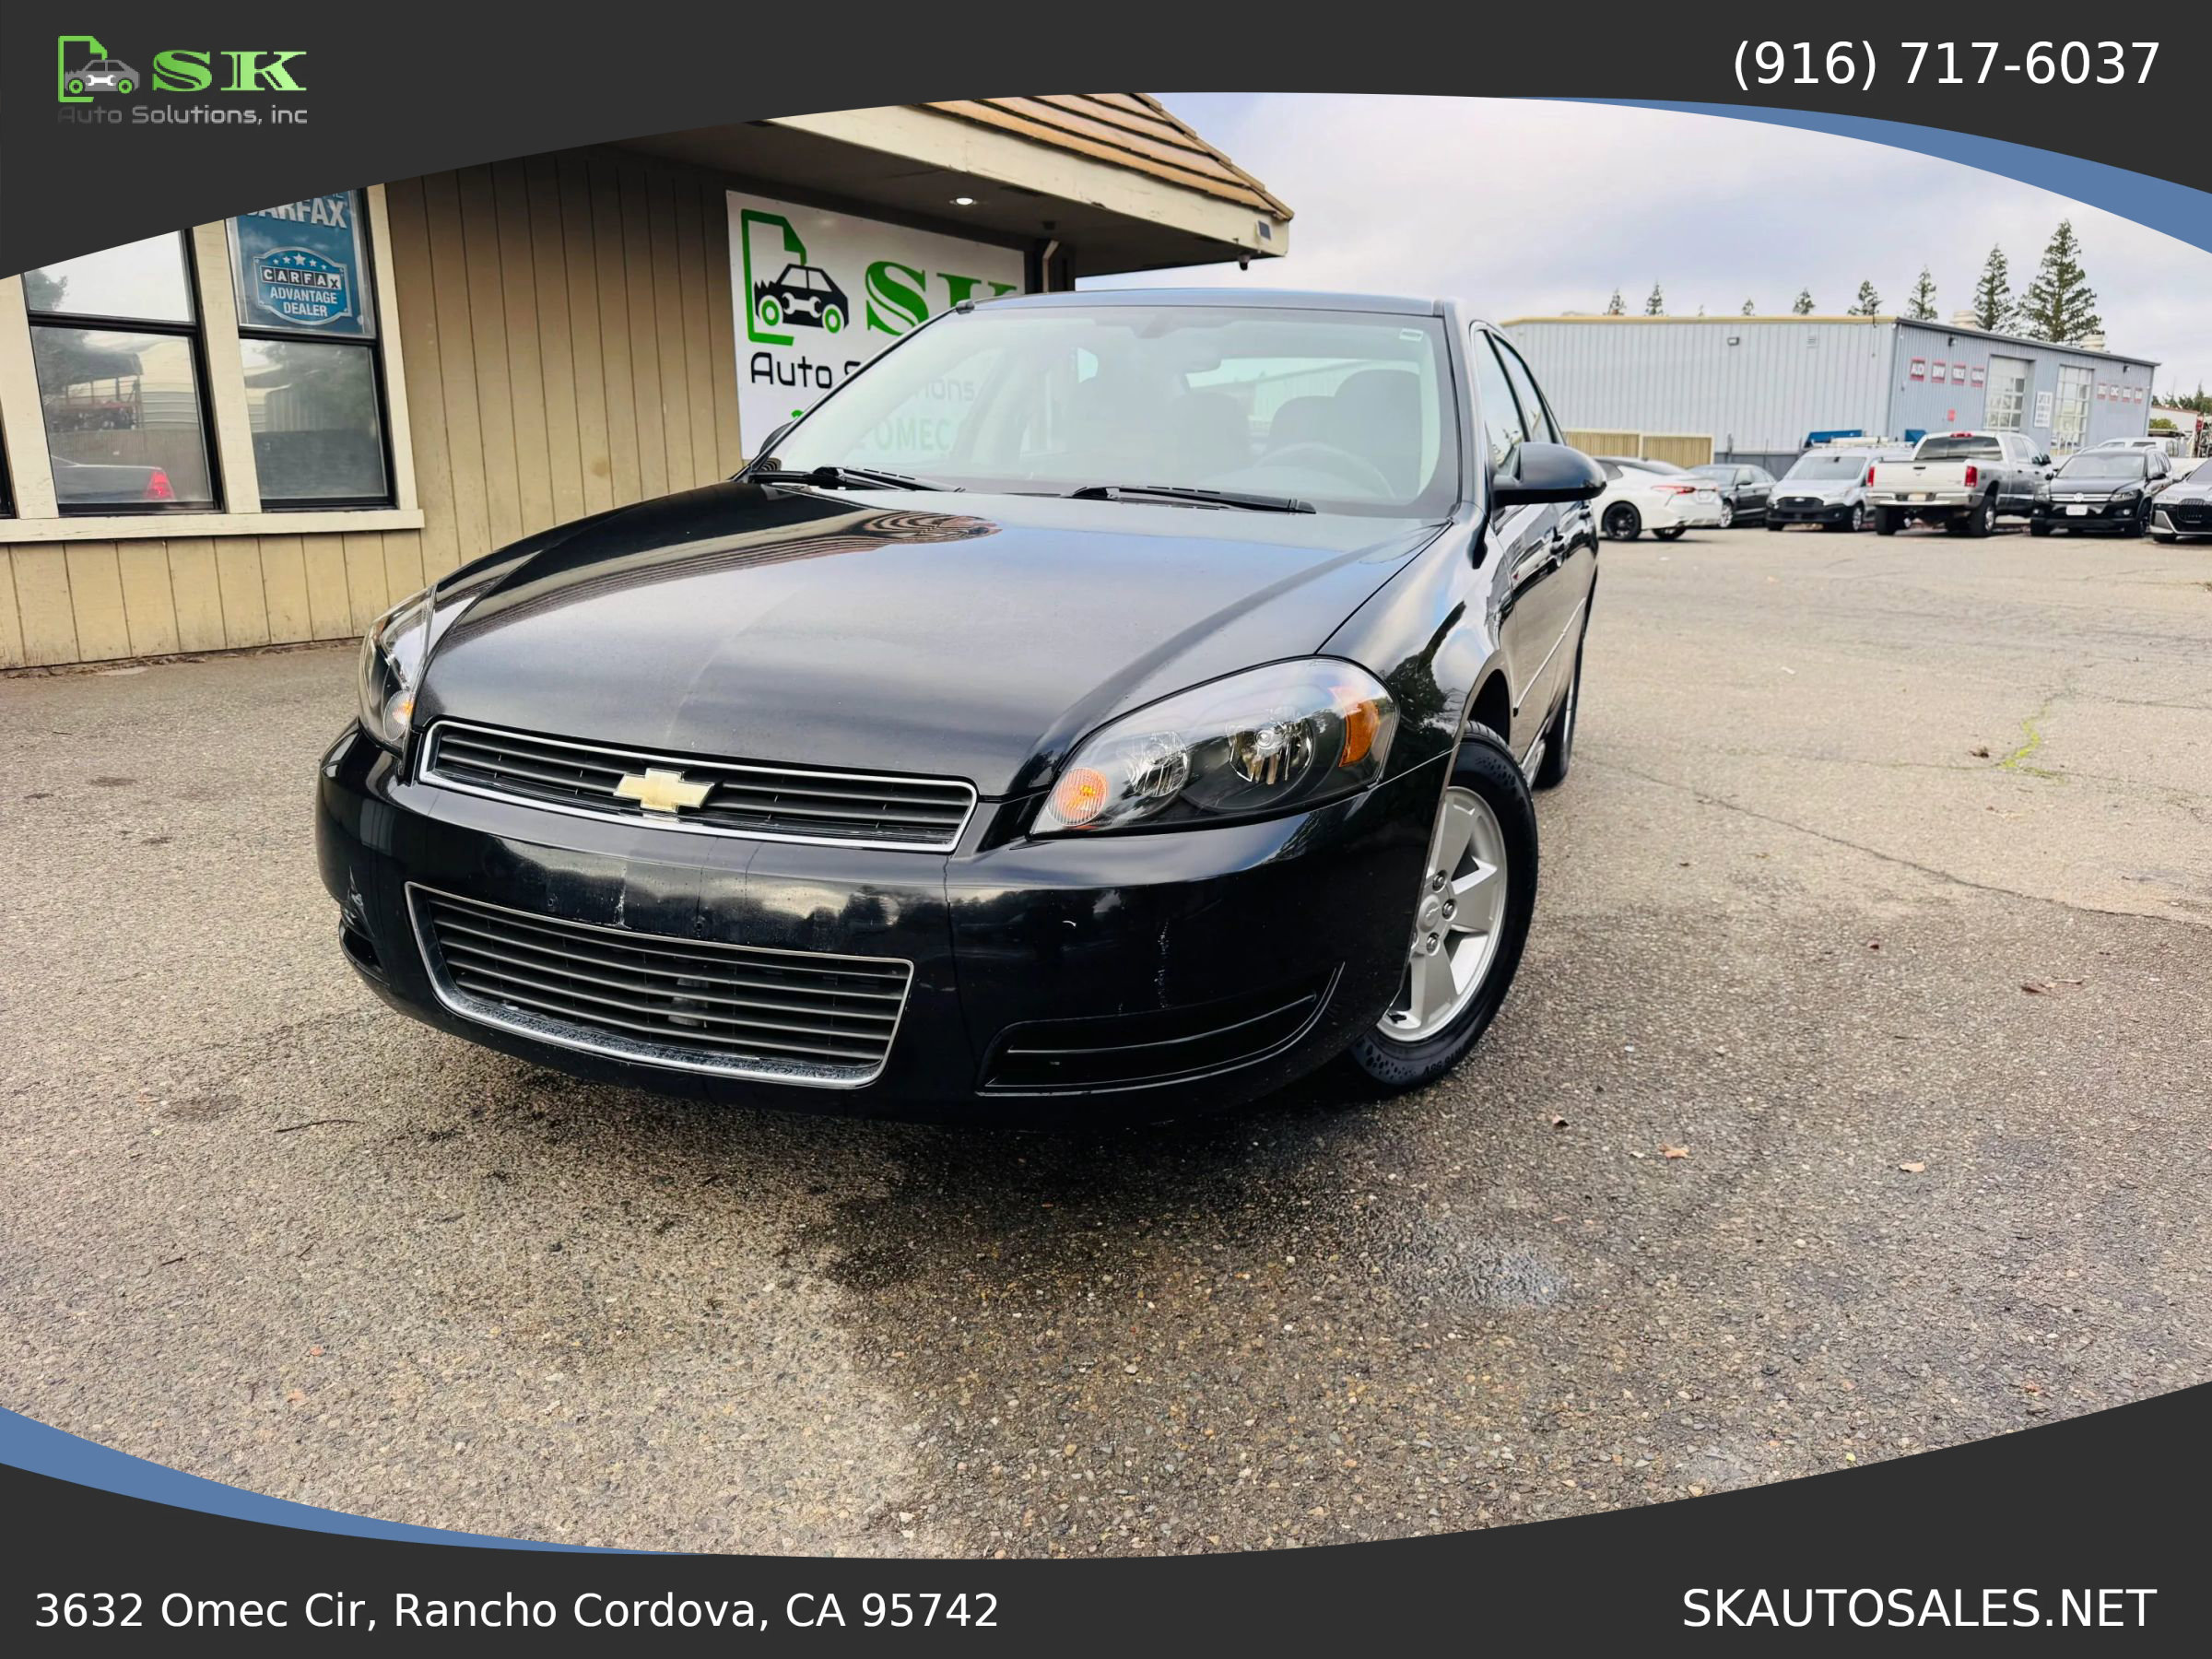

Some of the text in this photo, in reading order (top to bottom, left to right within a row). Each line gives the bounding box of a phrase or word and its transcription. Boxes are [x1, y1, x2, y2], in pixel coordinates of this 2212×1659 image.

[246, 197, 347, 229] RFAX
[263, 268, 340, 289] CARFAX
[270, 287, 338, 304] ADVANTAGE
[283, 301, 328, 317] DEALER
[750, 351, 832, 390] Auto
[874, 418, 951, 452] OMEC
